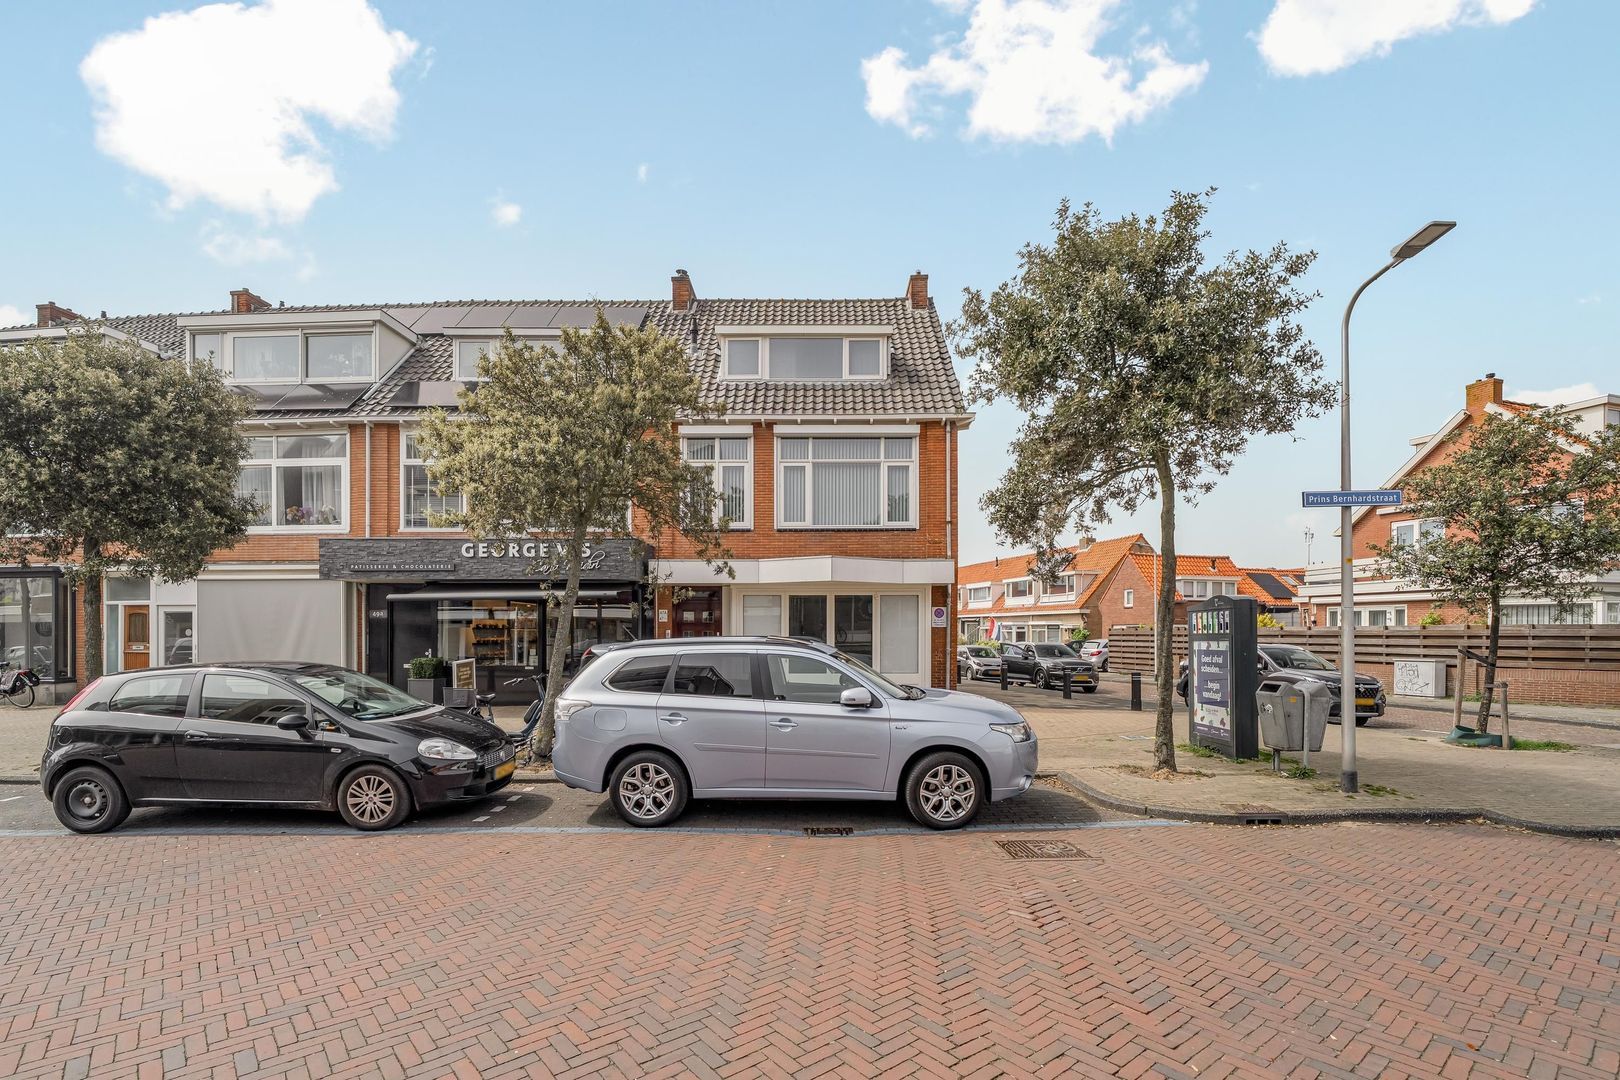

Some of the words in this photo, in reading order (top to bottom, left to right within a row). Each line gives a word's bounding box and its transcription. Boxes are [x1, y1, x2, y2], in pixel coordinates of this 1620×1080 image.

[1308, 495, 1330, 503] Prins
[1333, 494, 1397, 503] Bernhardstraat
[461, 542, 549, 558] GEORGE
